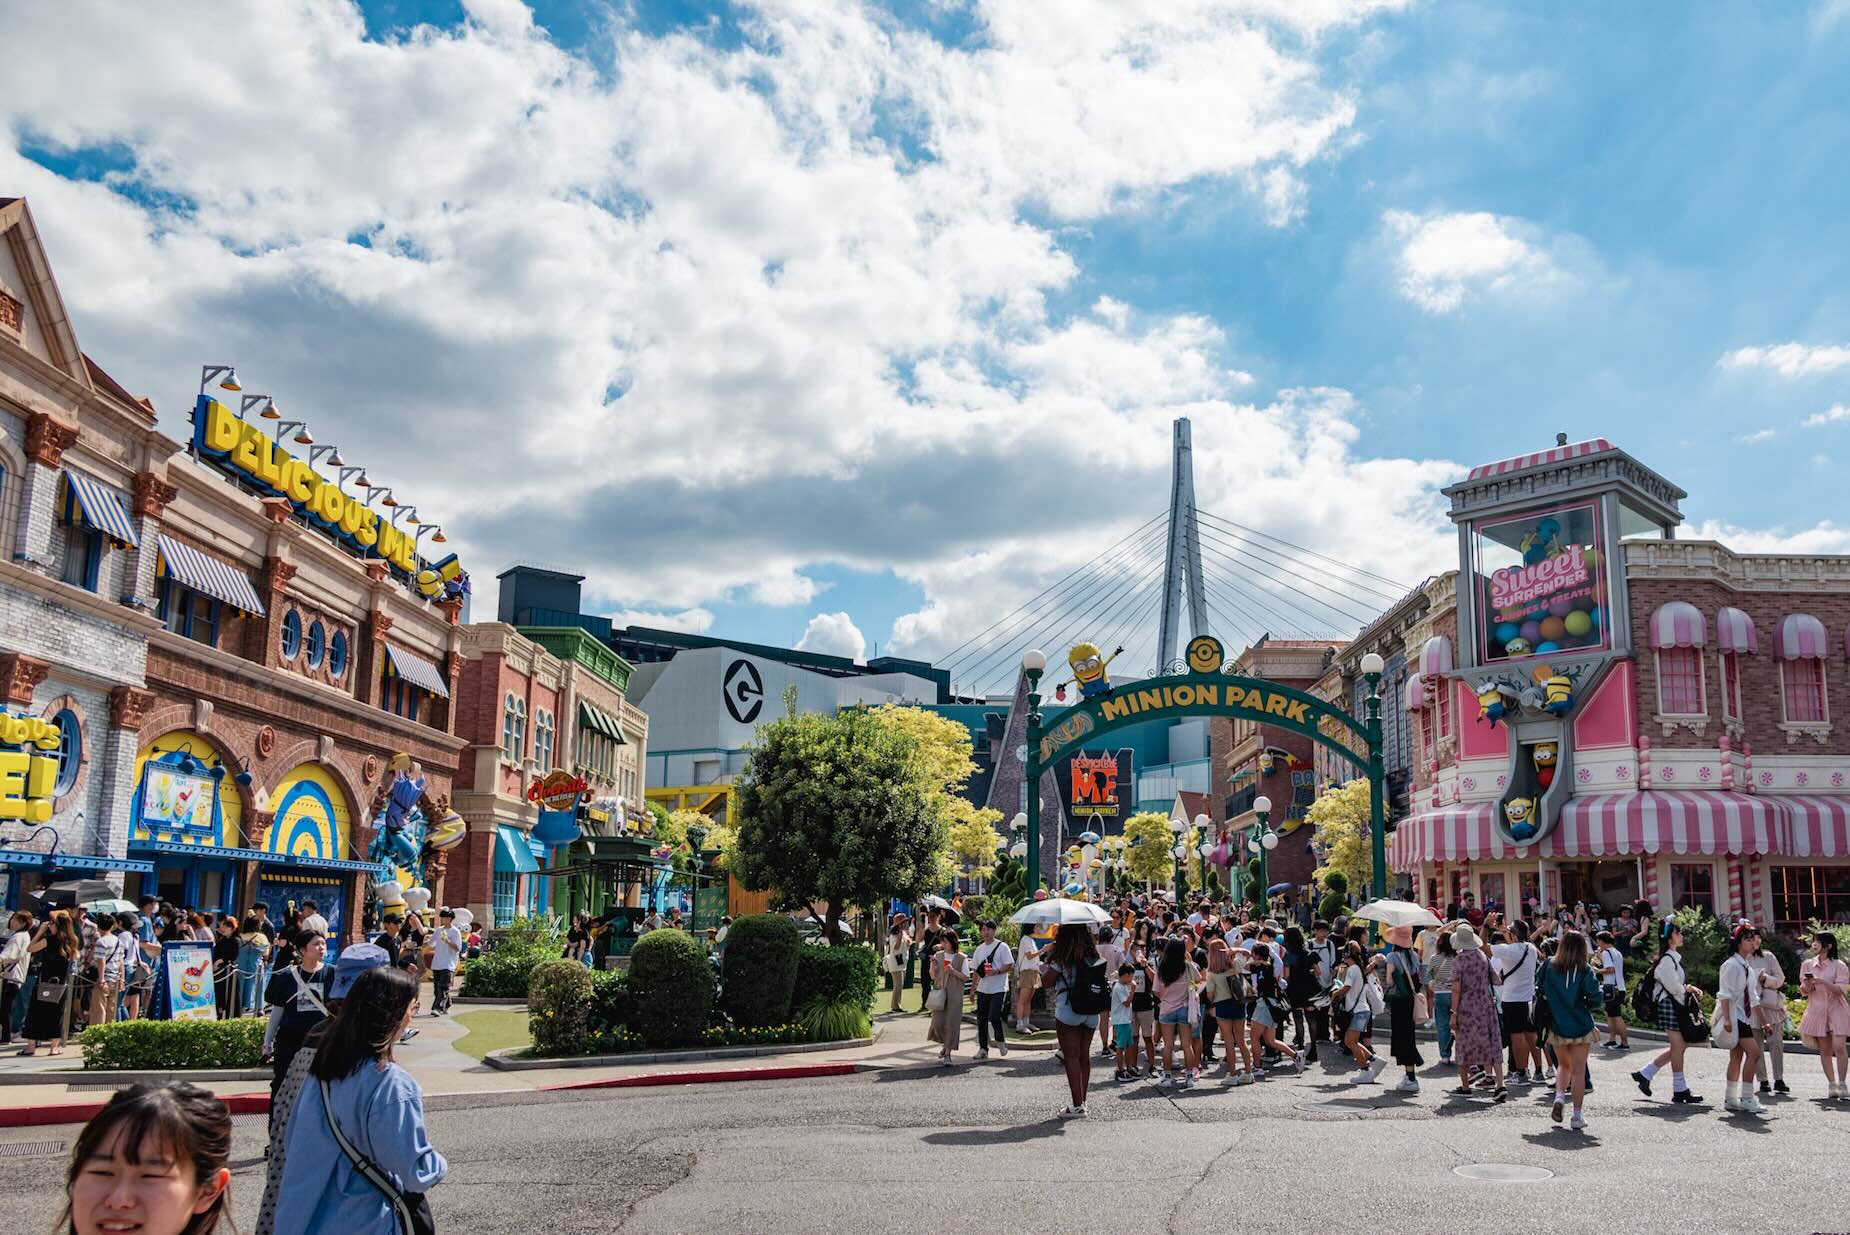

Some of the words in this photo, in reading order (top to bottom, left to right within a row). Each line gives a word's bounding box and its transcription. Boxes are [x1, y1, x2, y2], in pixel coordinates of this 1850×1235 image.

[205, 400, 378, 546] DELICIOUS
[377, 520, 417, 573] ME
[1492, 544, 1585, 597] Sweet
[1492, 569, 1588, 609] SURRENDER
[1494, 604, 1539, 623] CANDIES
[1550, 587, 1592, 604] TREATS
[1101, 685, 1219, 721] MINION
[1225, 686, 1310, 724] PARK
[1071, 758, 1118, 769] DESPICABLE
[1071, 768, 1119, 804] ME
[1074, 807, 1093, 815] MINION
